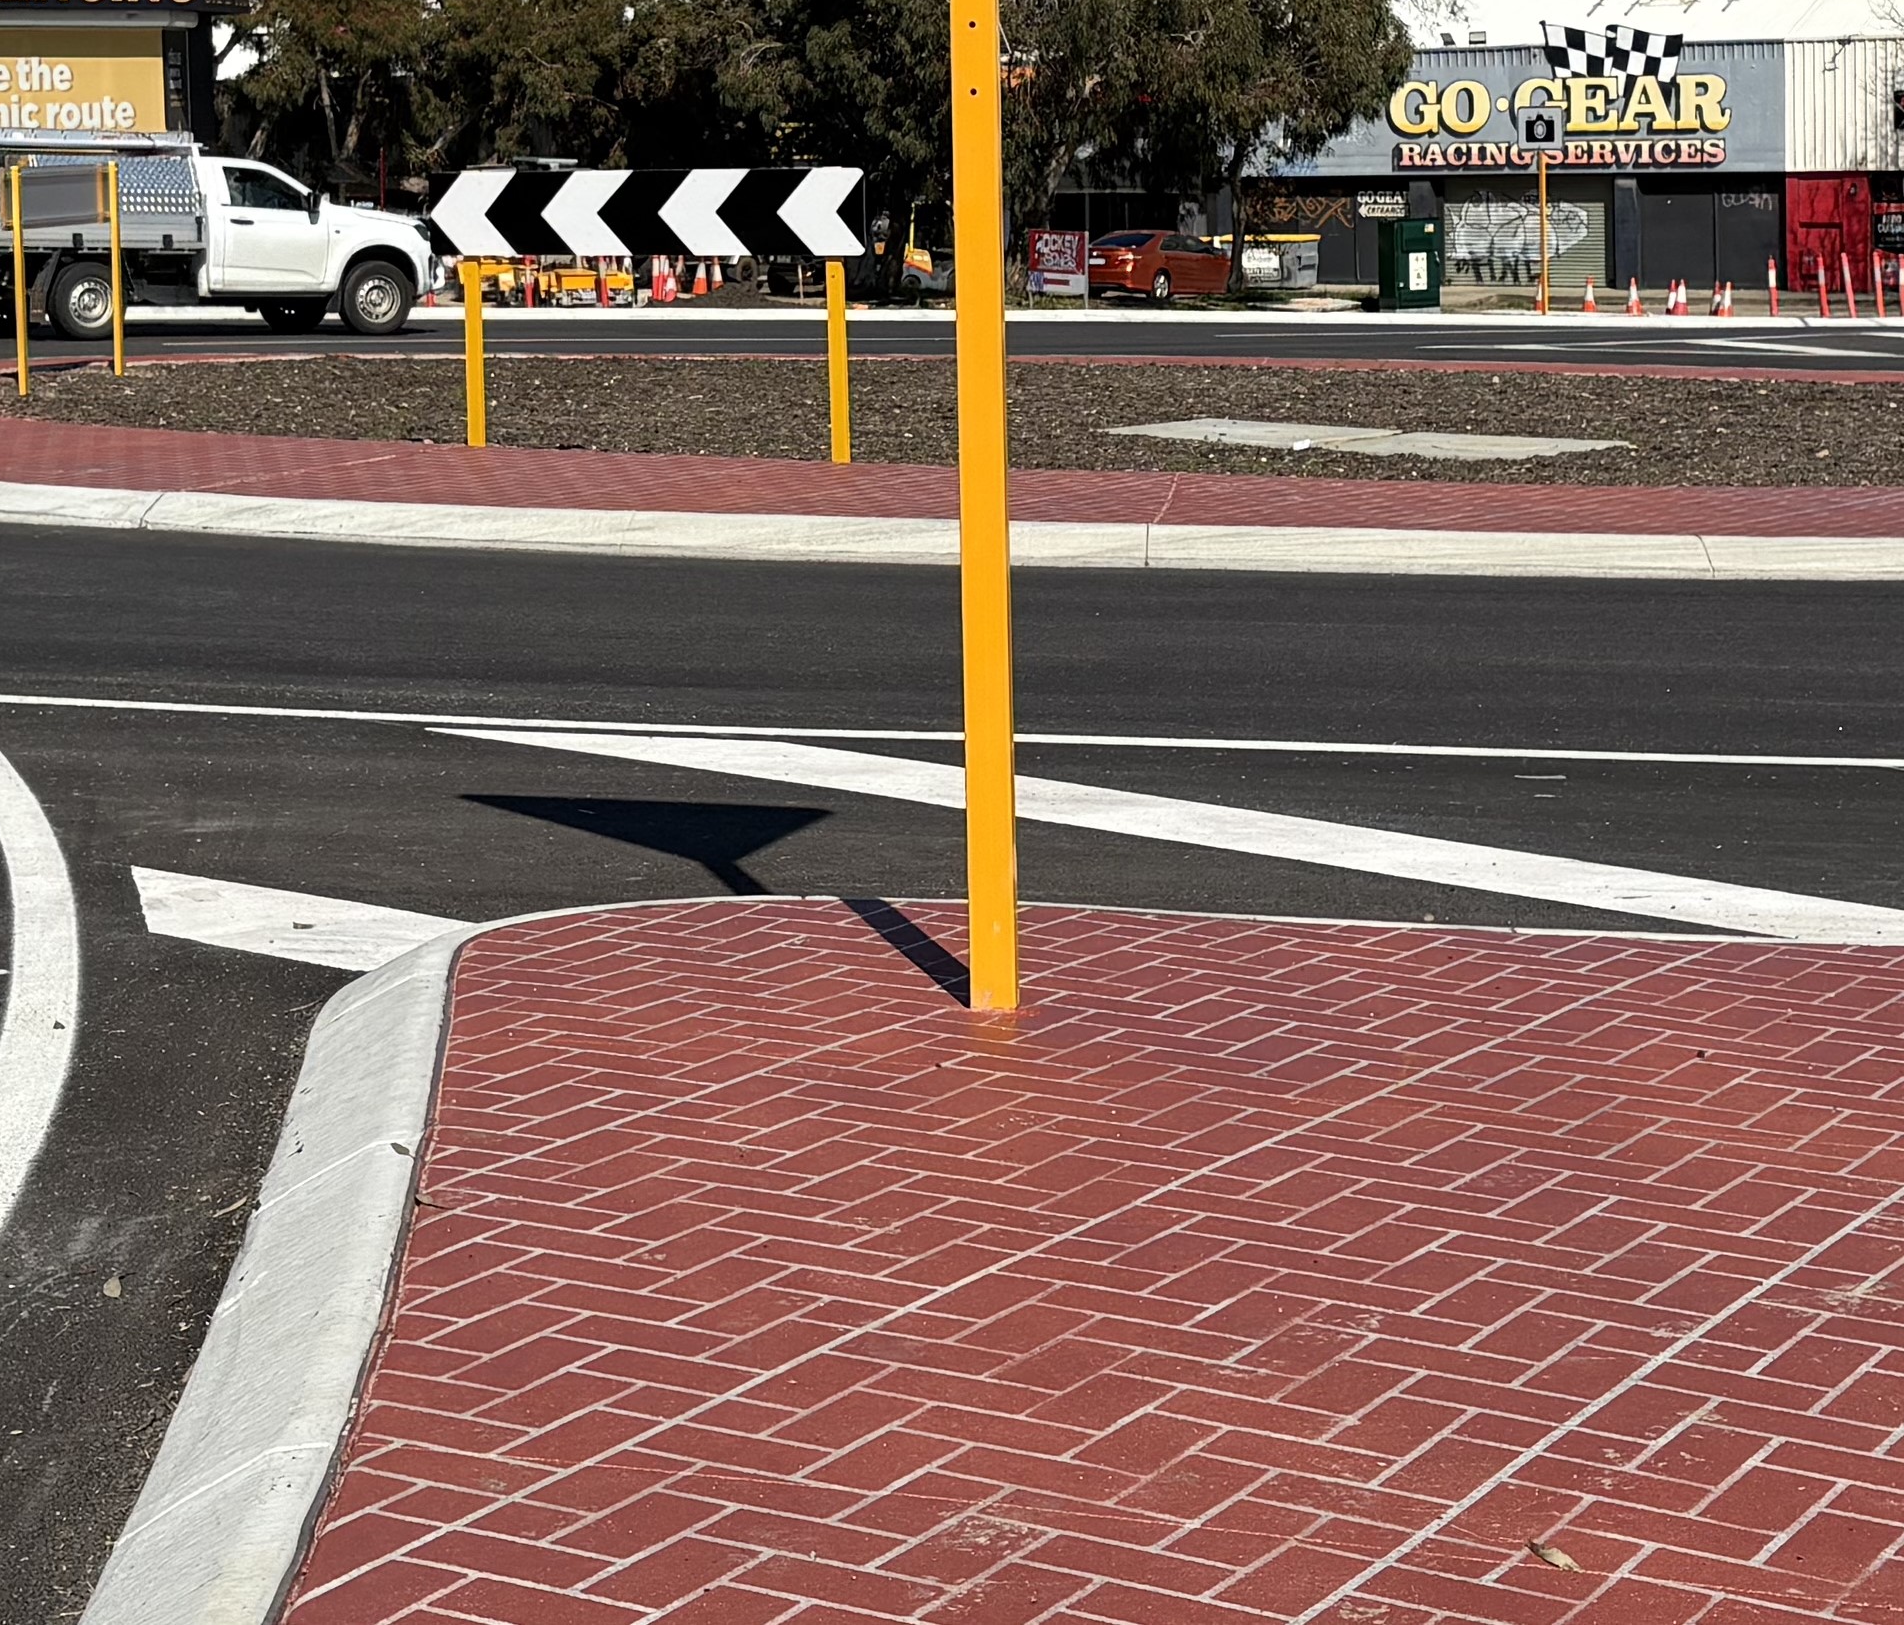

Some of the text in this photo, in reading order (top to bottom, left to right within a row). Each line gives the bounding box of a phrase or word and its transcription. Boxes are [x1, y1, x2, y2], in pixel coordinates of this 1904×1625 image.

[15, 56, 75, 92] the
[46, 95, 137, 131] route
[1398, 138, 1726, 169] RACING SERVICES
